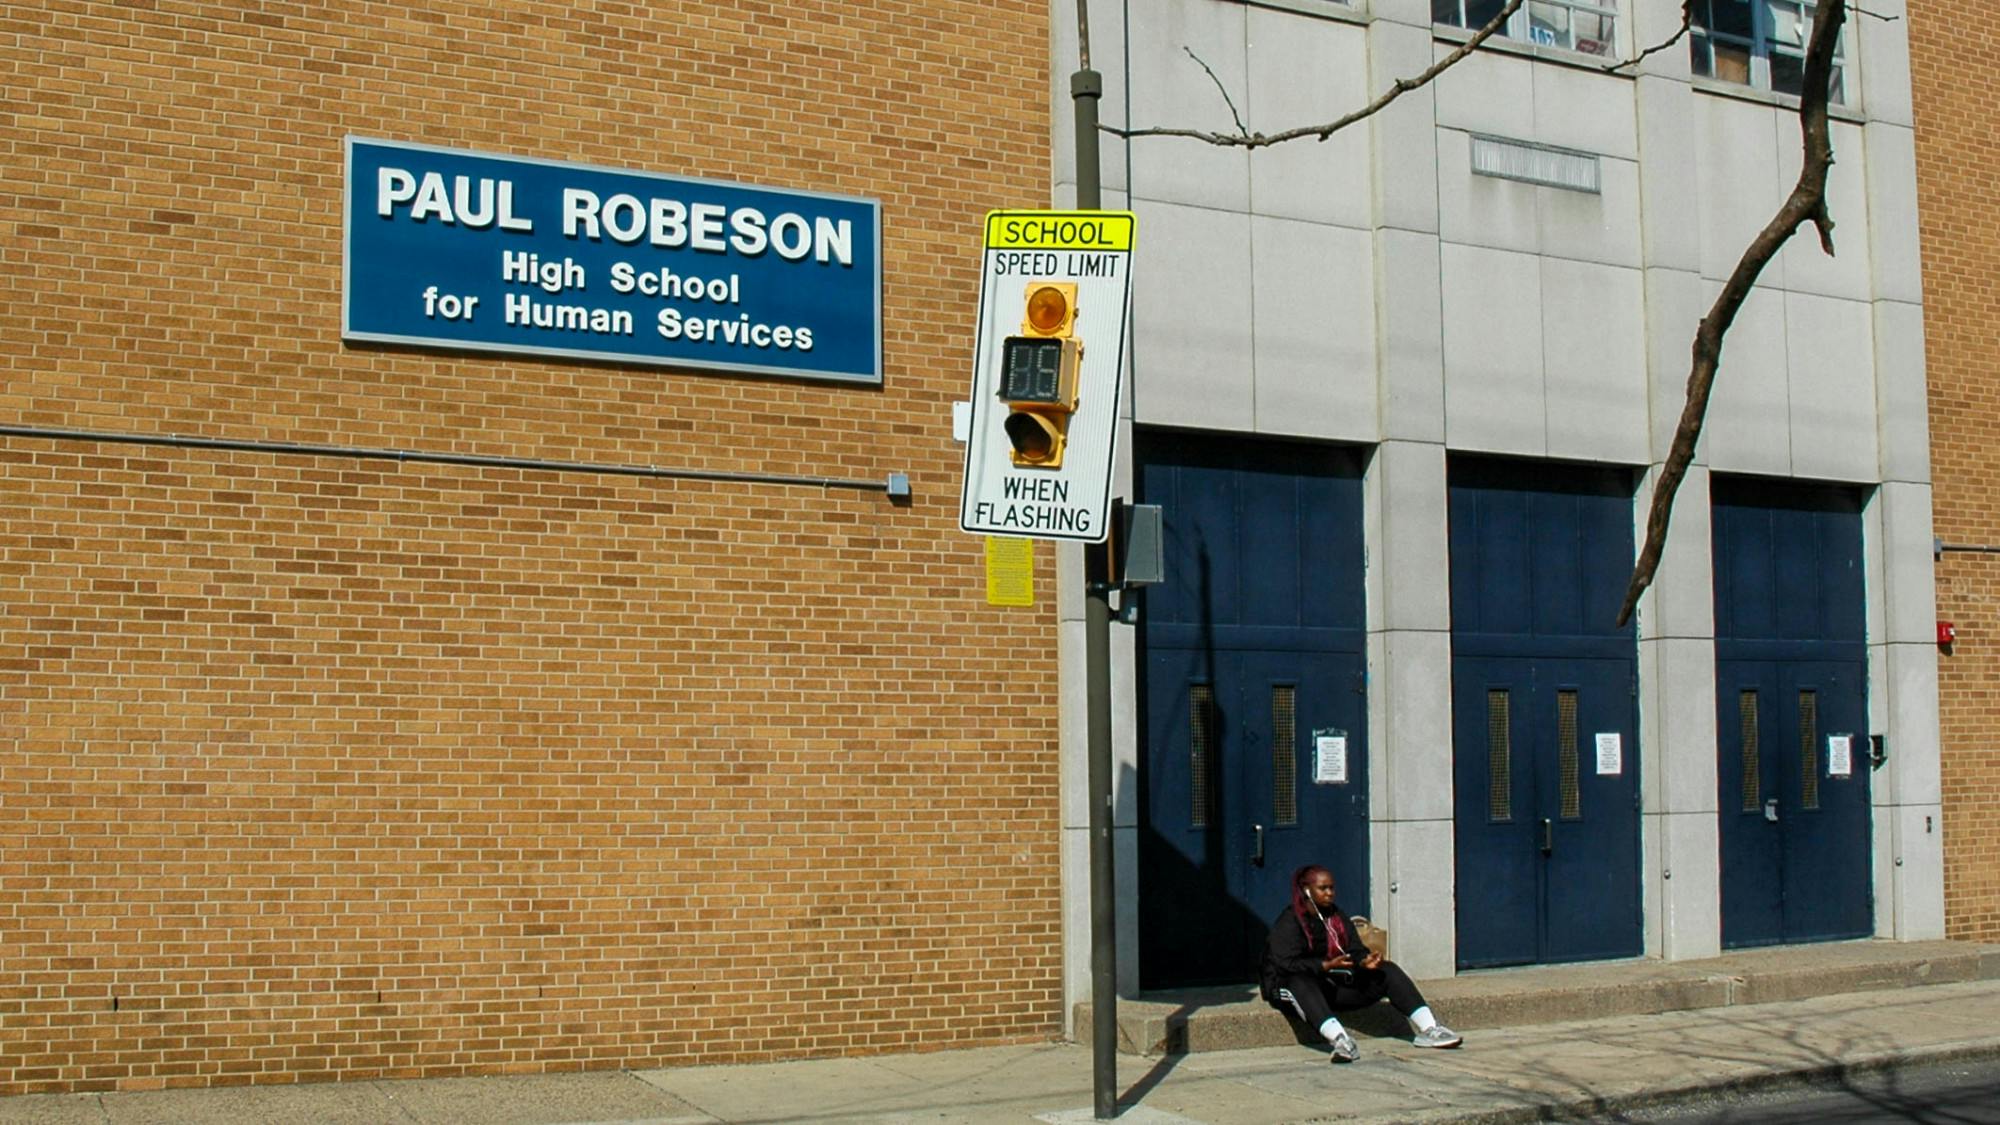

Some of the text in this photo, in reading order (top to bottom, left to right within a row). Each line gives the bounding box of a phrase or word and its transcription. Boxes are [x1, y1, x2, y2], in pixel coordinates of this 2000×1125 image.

[378, 167, 853, 265] PAUL ROBESON
[1004, 221, 1113, 245] SCHOOL
[503, 250, 740, 303] High School
[994, 252, 1120, 278] SPEED LIMIT
[423, 286, 814, 350] for Human Services
[1003, 476, 1070, 503] WHEN
[974, 502, 1090, 532] FLASHING
